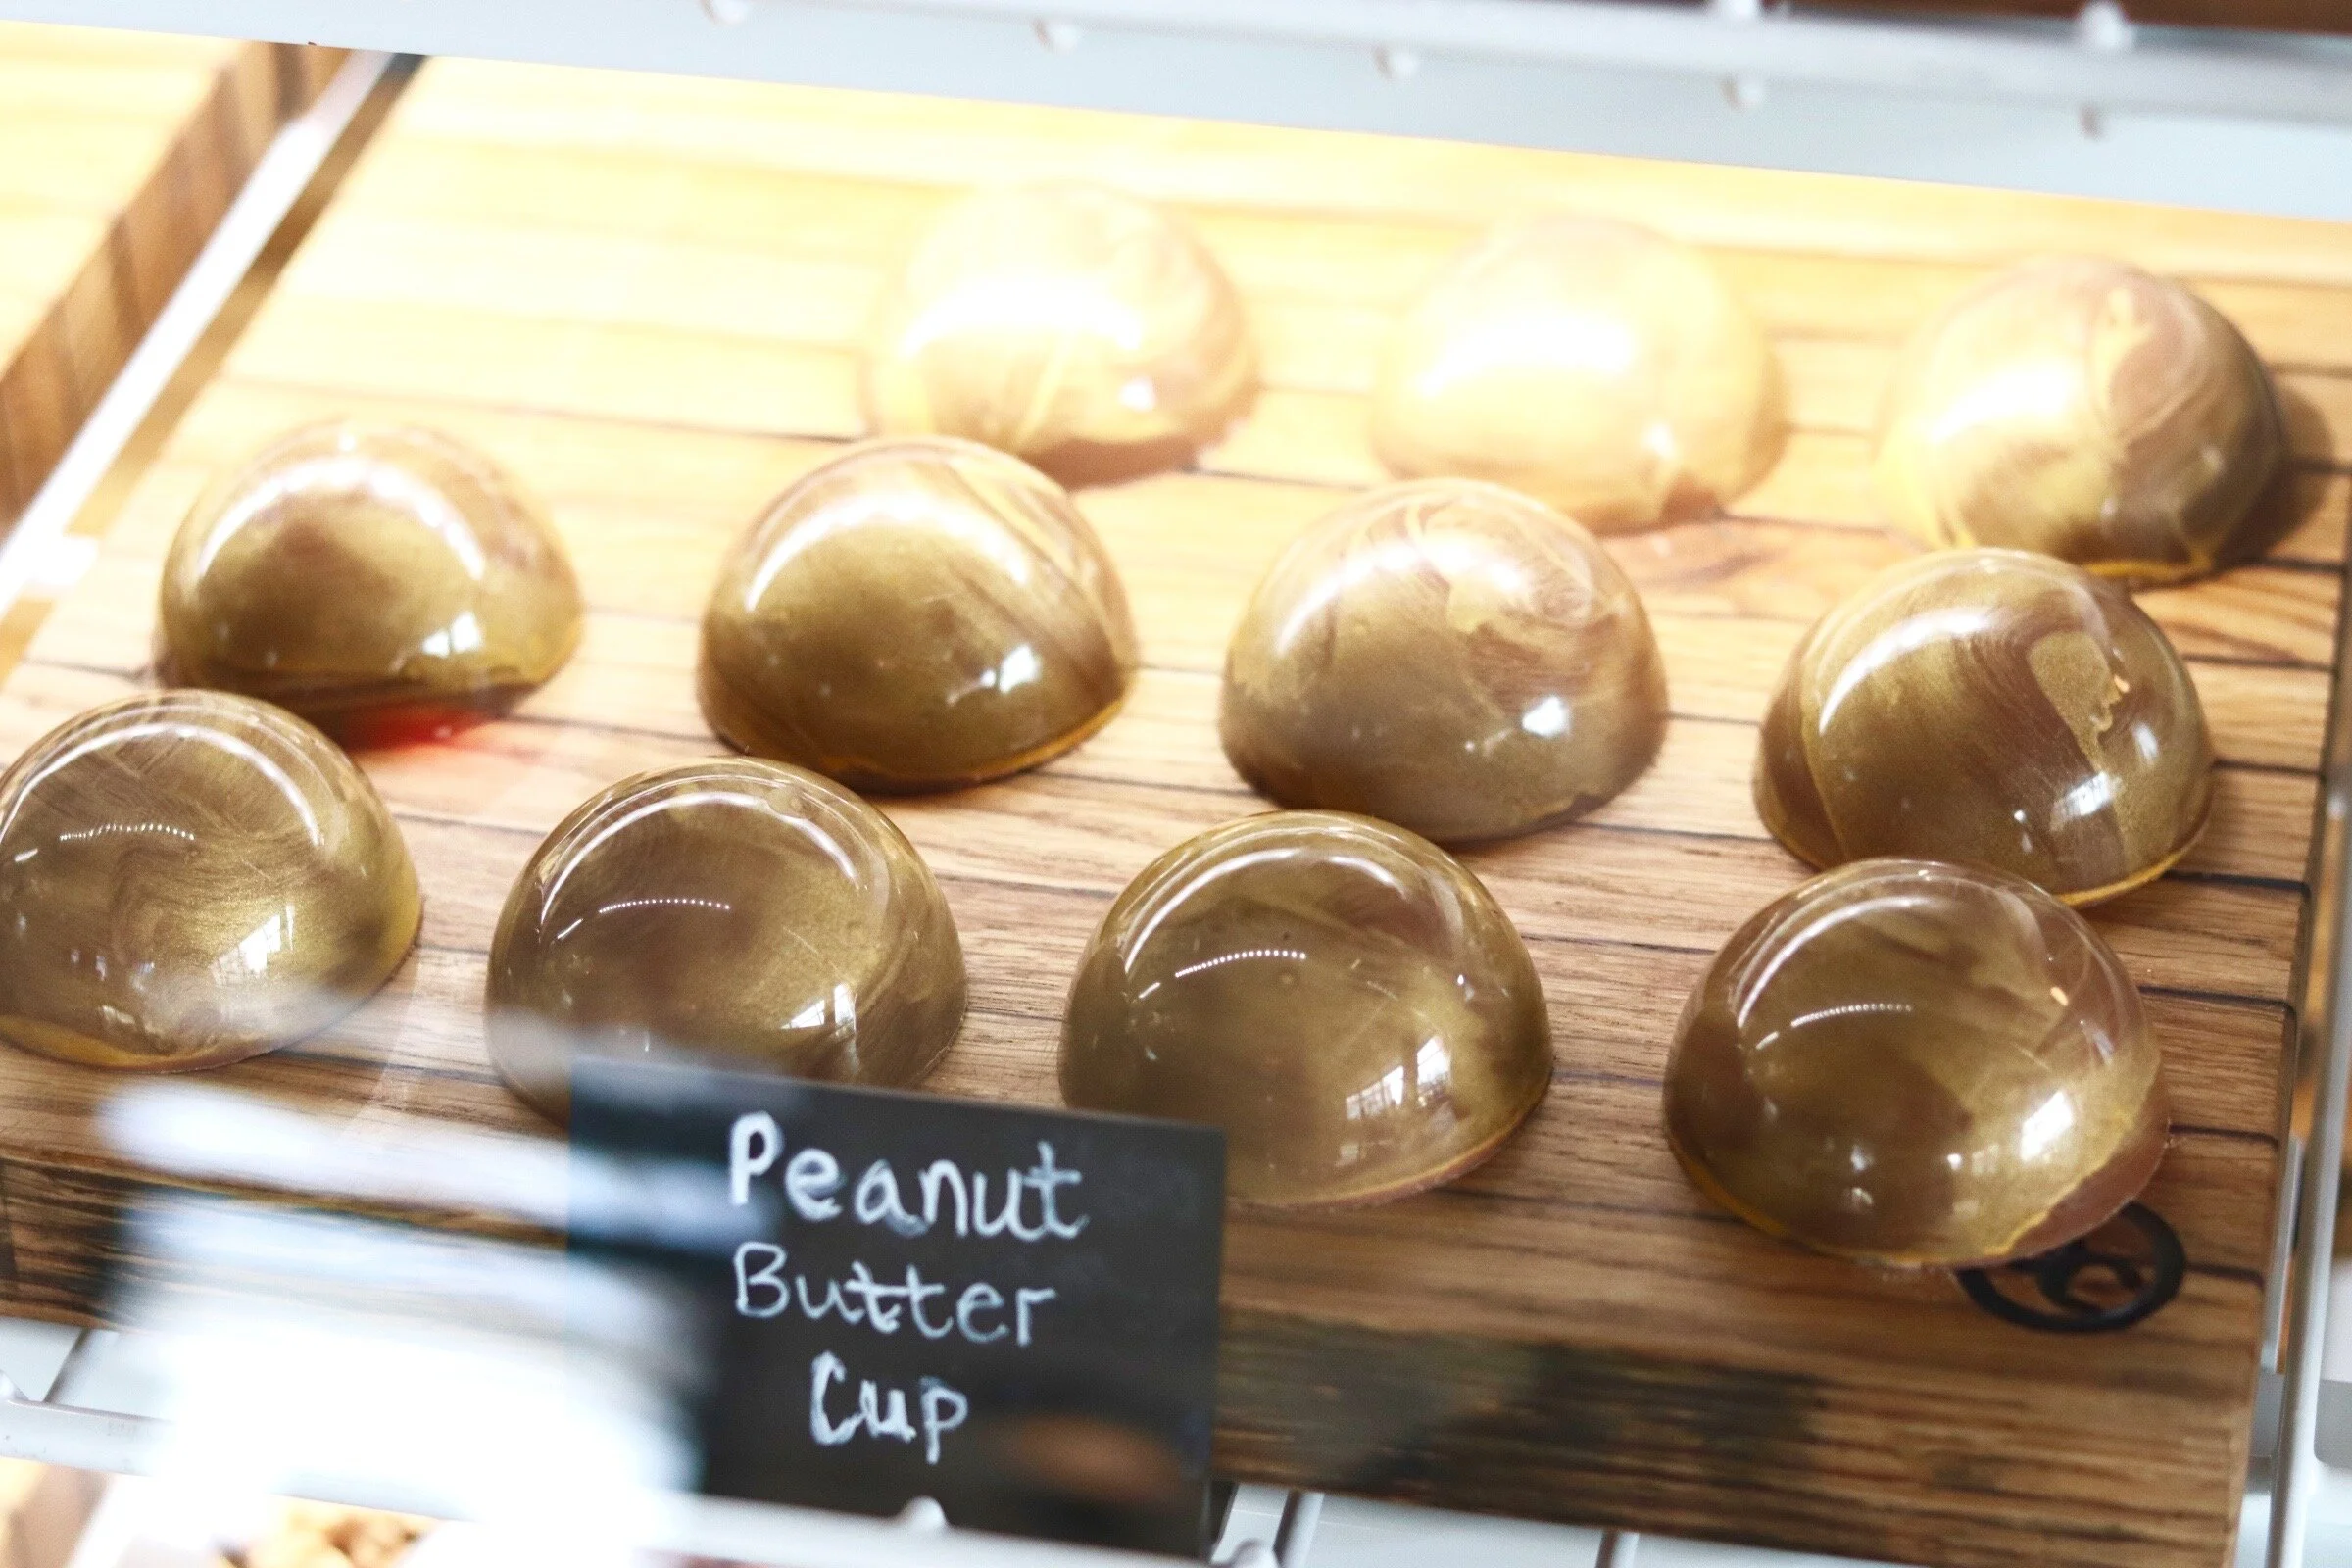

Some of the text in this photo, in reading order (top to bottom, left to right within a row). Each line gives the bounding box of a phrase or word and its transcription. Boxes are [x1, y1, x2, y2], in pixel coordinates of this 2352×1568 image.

[728, 1110, 1089, 1241] Peanut
[732, 1240, 1056, 1347] Butter
[809, 1350, 969, 1464] Cup
